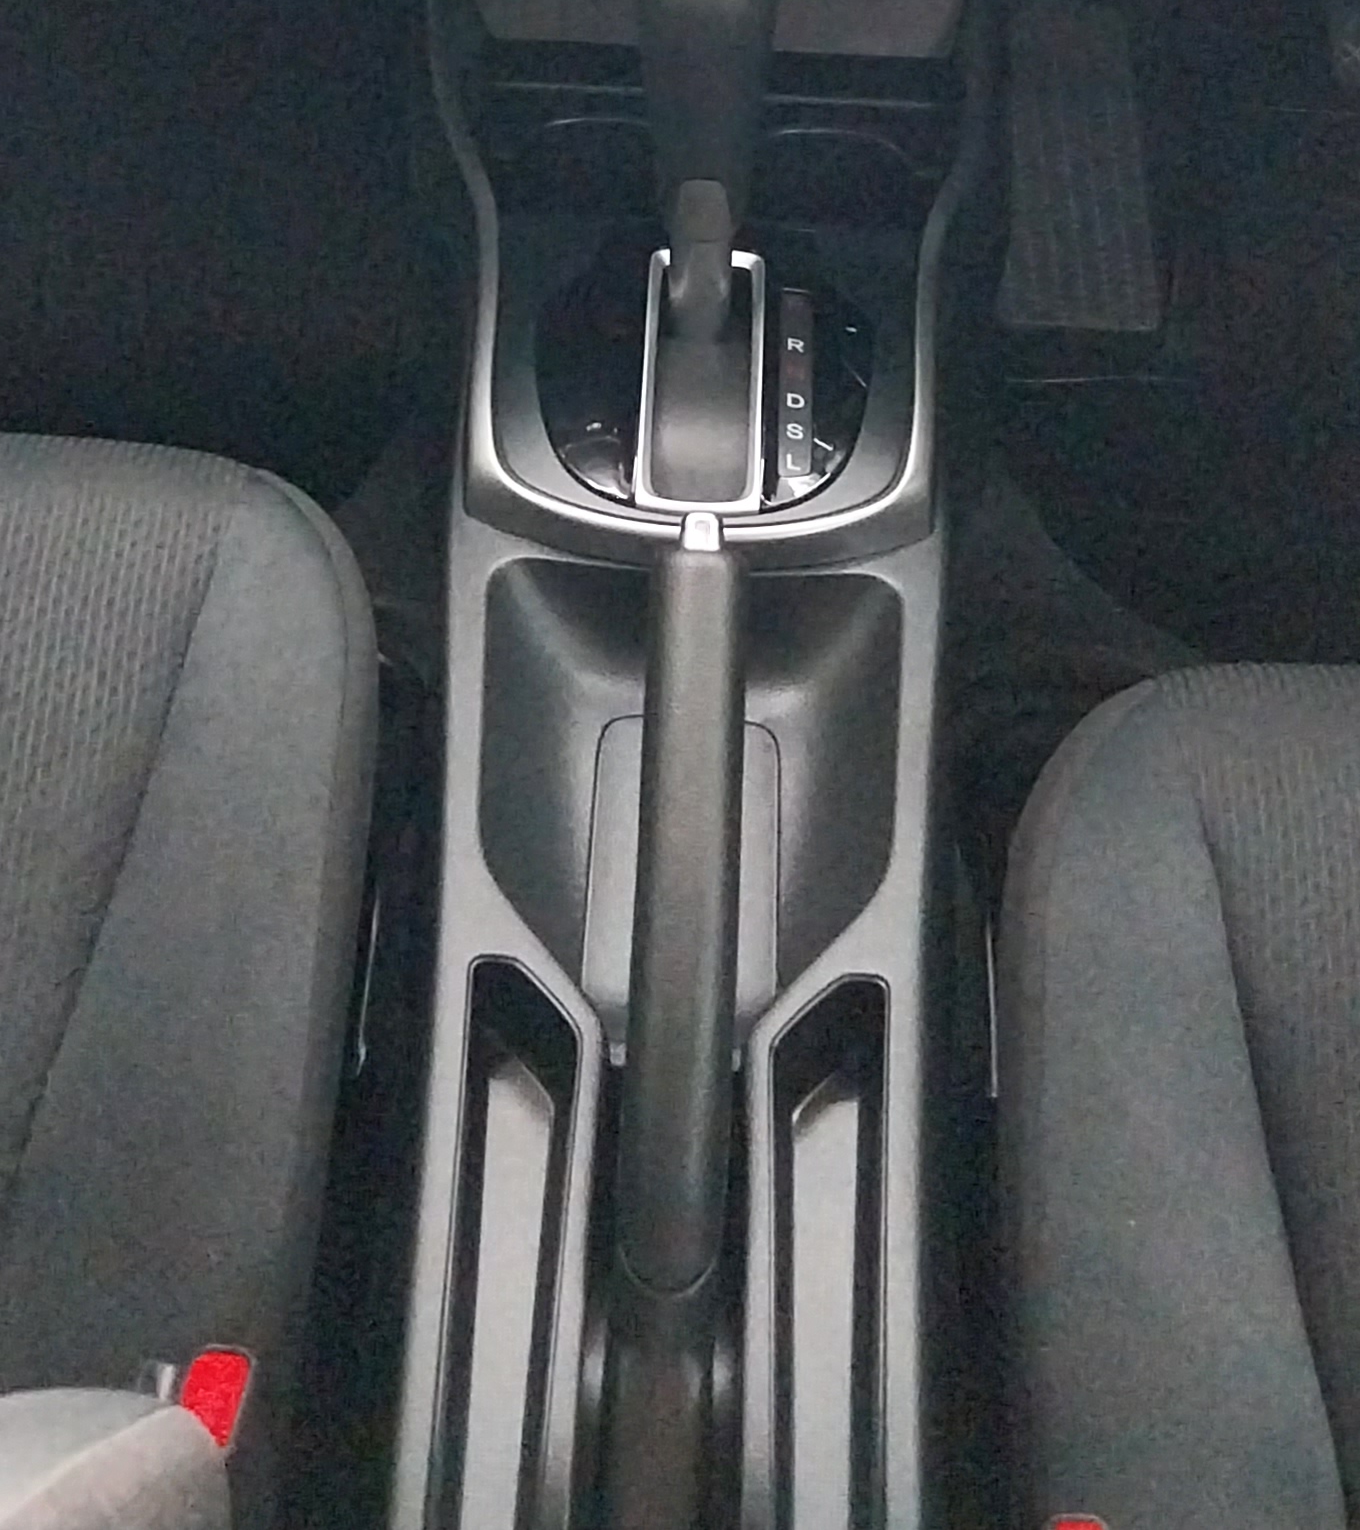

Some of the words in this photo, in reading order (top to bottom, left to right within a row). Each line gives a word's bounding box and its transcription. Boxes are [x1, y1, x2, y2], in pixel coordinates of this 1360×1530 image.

[787, 337, 805, 354] R
[786, 392, 806, 409] D
[786, 423, 804, 440] S
[786, 453, 802, 471] L
